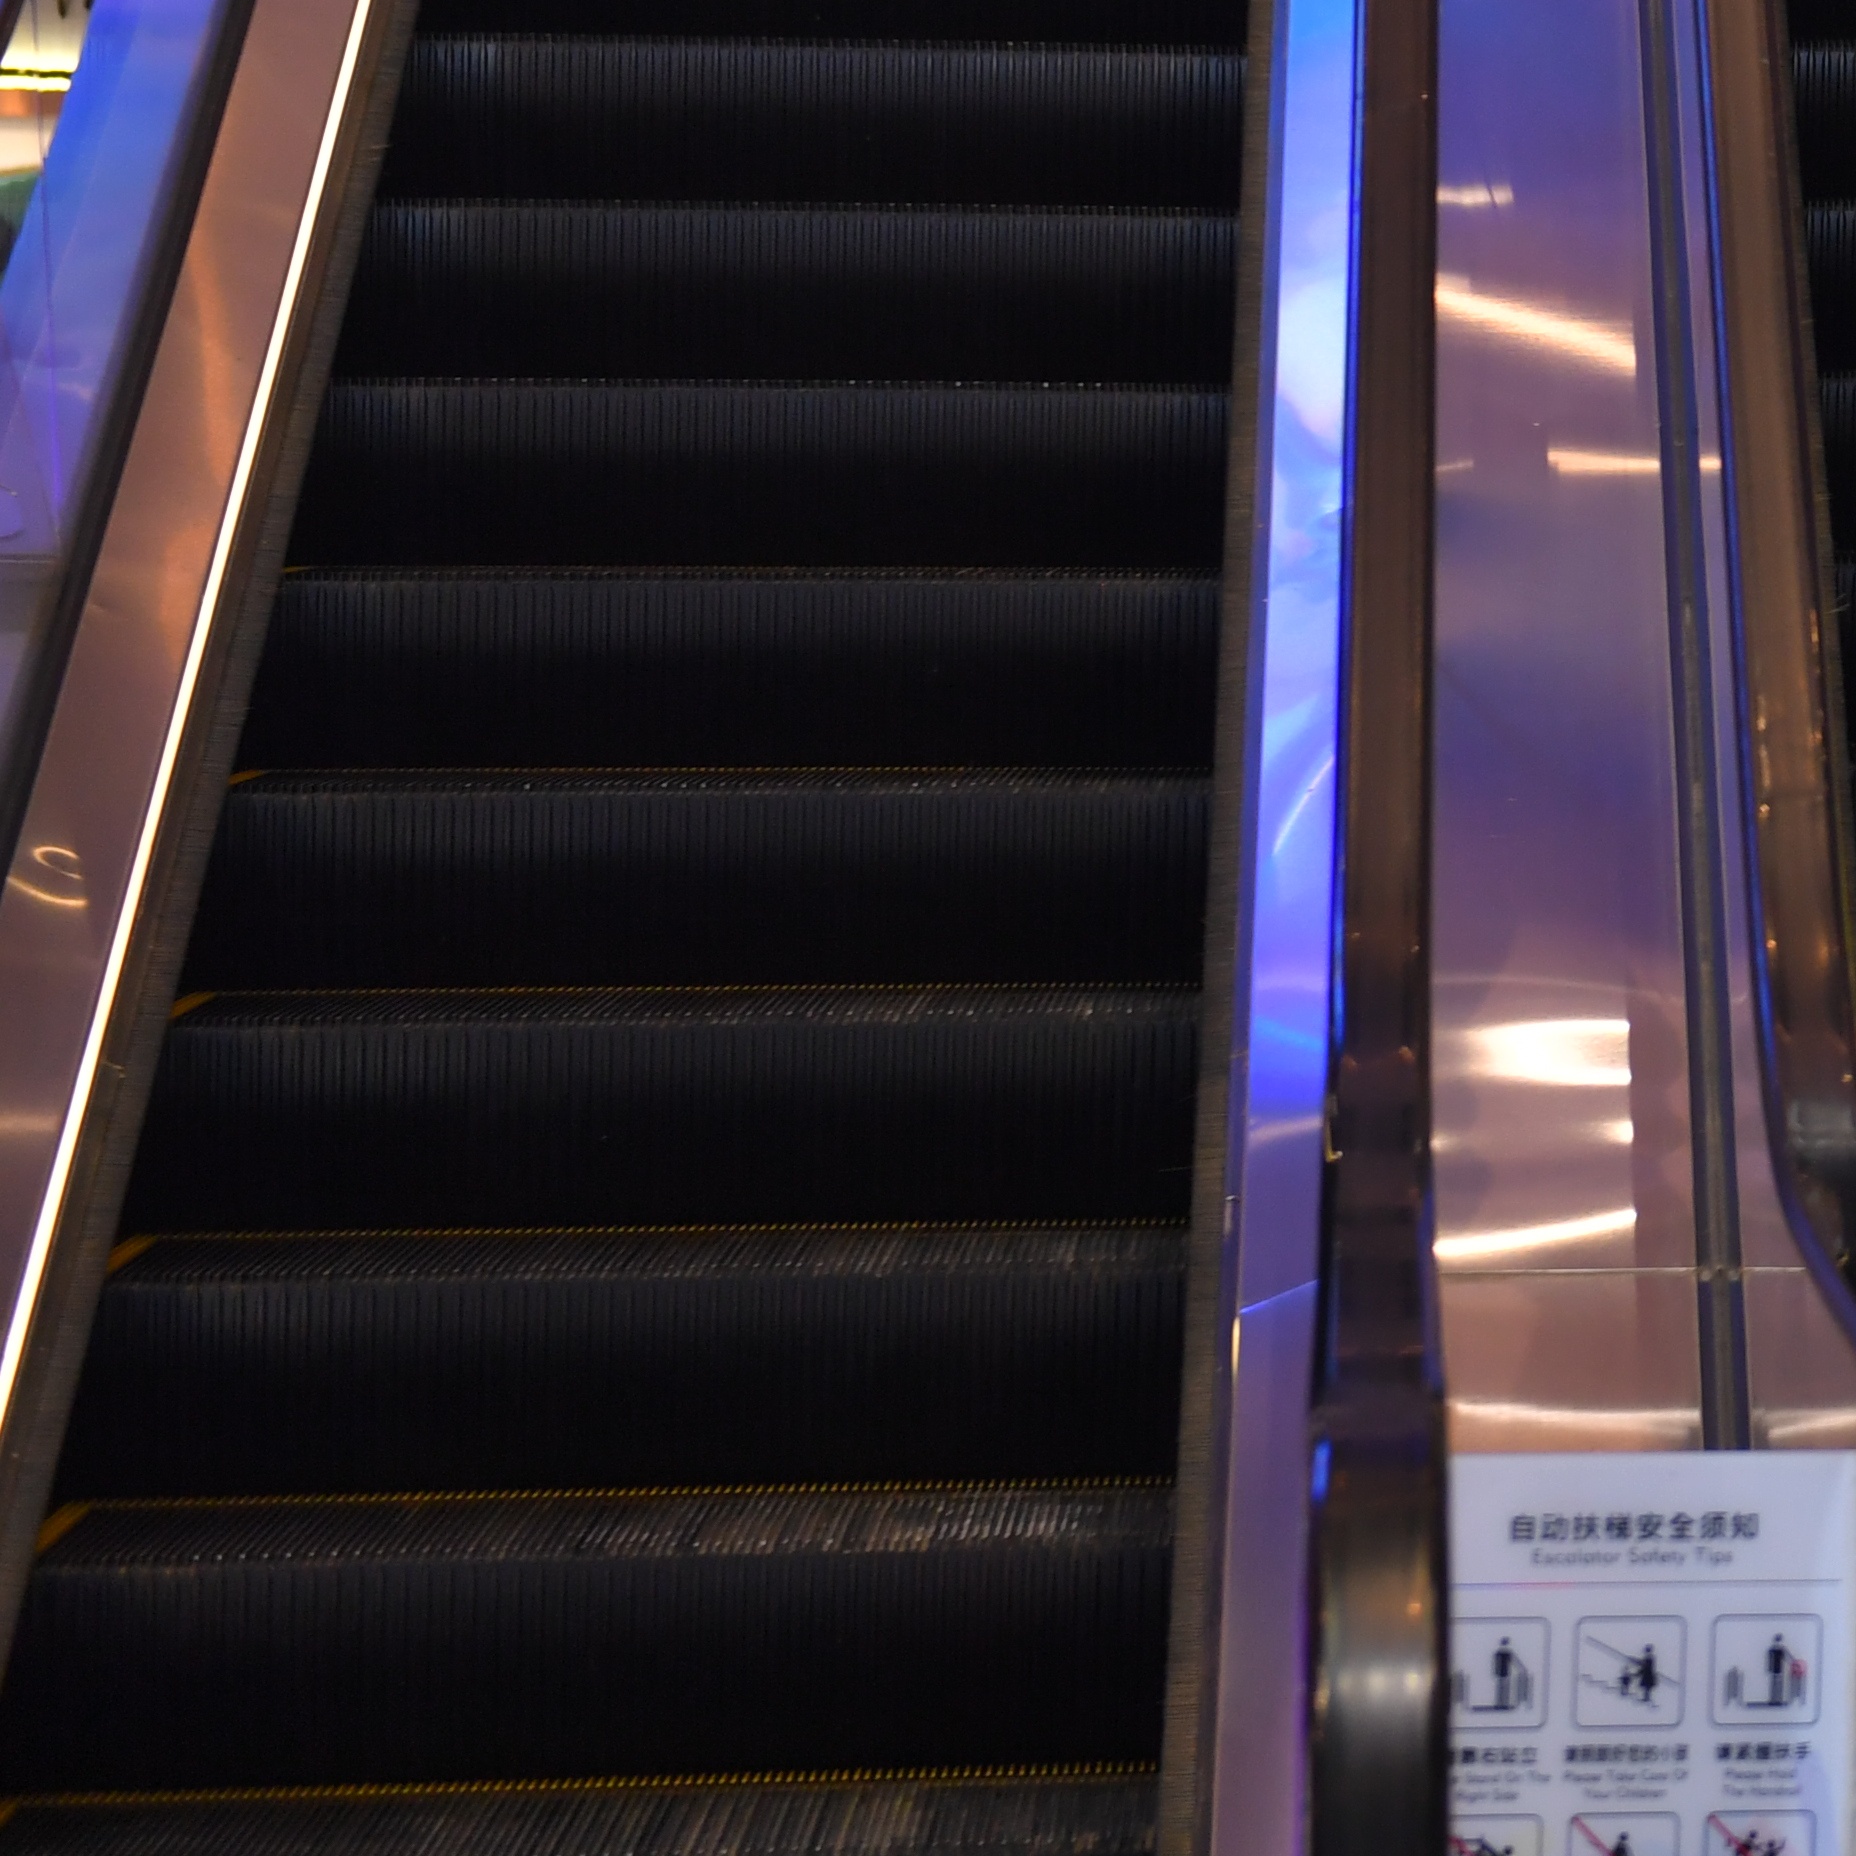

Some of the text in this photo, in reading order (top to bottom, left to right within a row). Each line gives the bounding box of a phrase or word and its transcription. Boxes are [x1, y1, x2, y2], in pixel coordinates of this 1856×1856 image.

[1511, 1512, 1760, 1541] 自动扶梯安全须知
